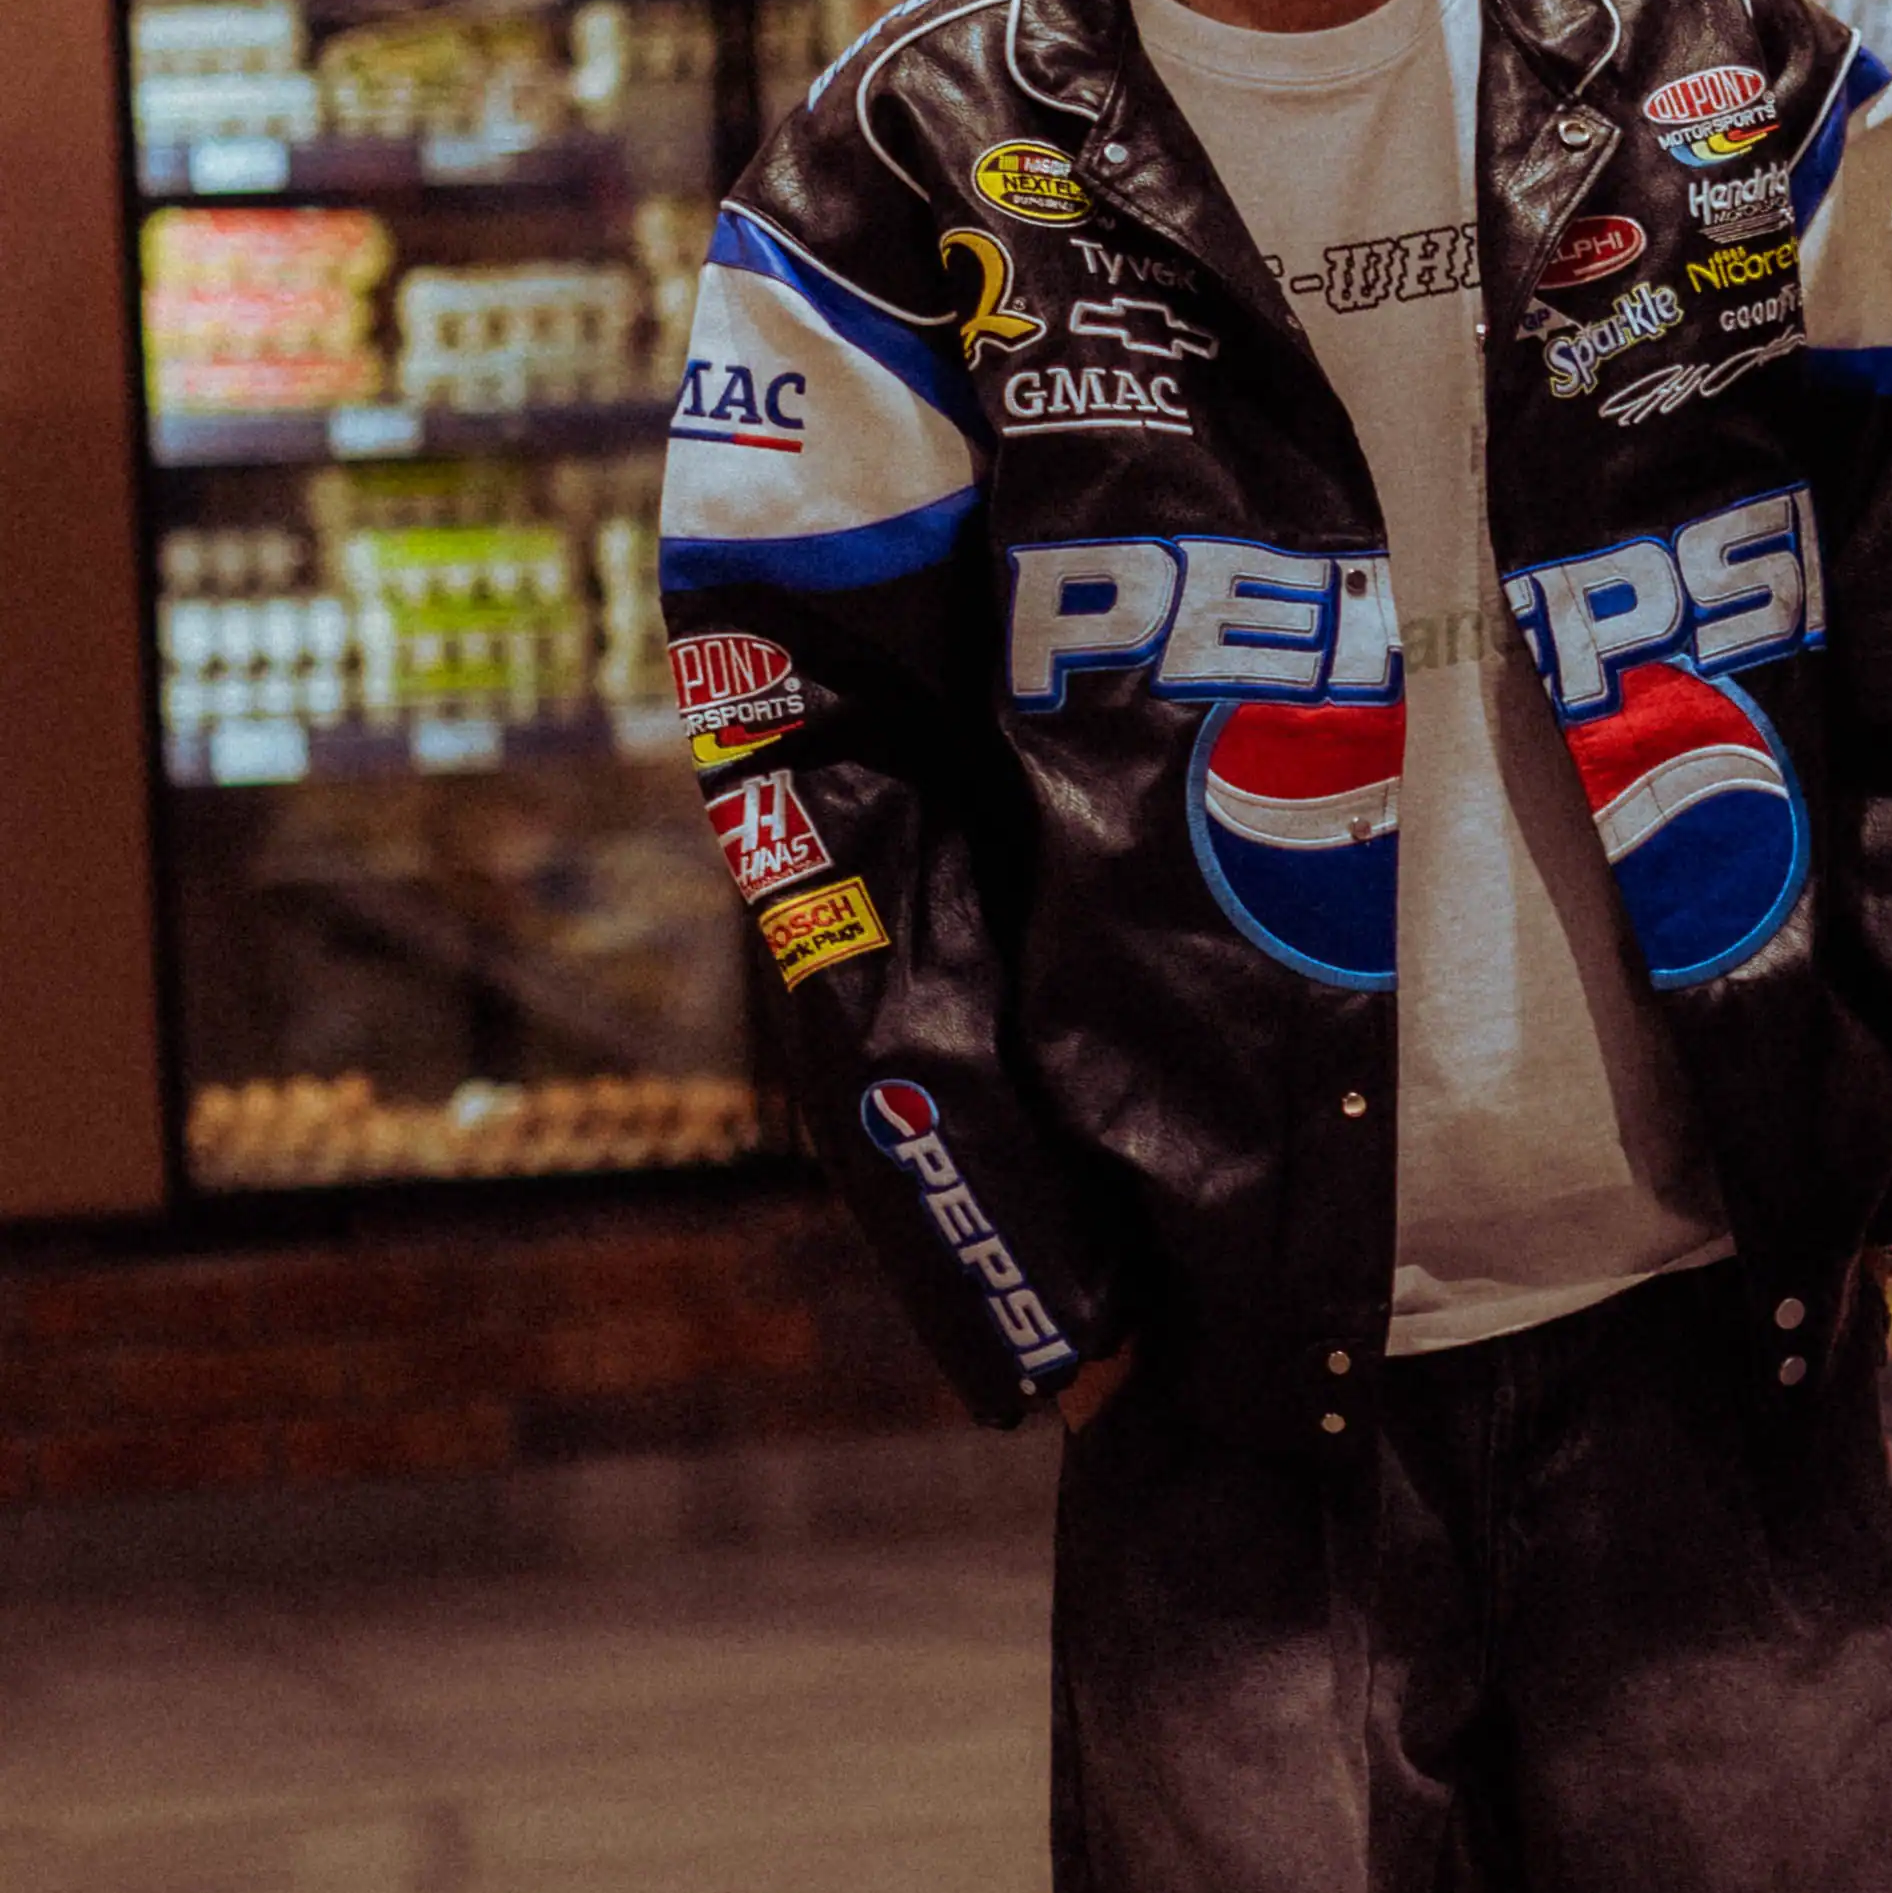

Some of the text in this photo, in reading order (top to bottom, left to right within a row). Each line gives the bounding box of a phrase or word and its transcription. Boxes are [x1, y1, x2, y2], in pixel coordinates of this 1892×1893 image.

[1657, 104, 1776, 151] MOTORSPORTS
[1552, 231, 1625, 265] LPHI
[1545, 281, 1685, 398] Sparkle
[1003, 366, 1188, 419] GMAC
[739, 836, 810, 886] HAAS
[894, 1131, 1079, 1376] PEPSI
